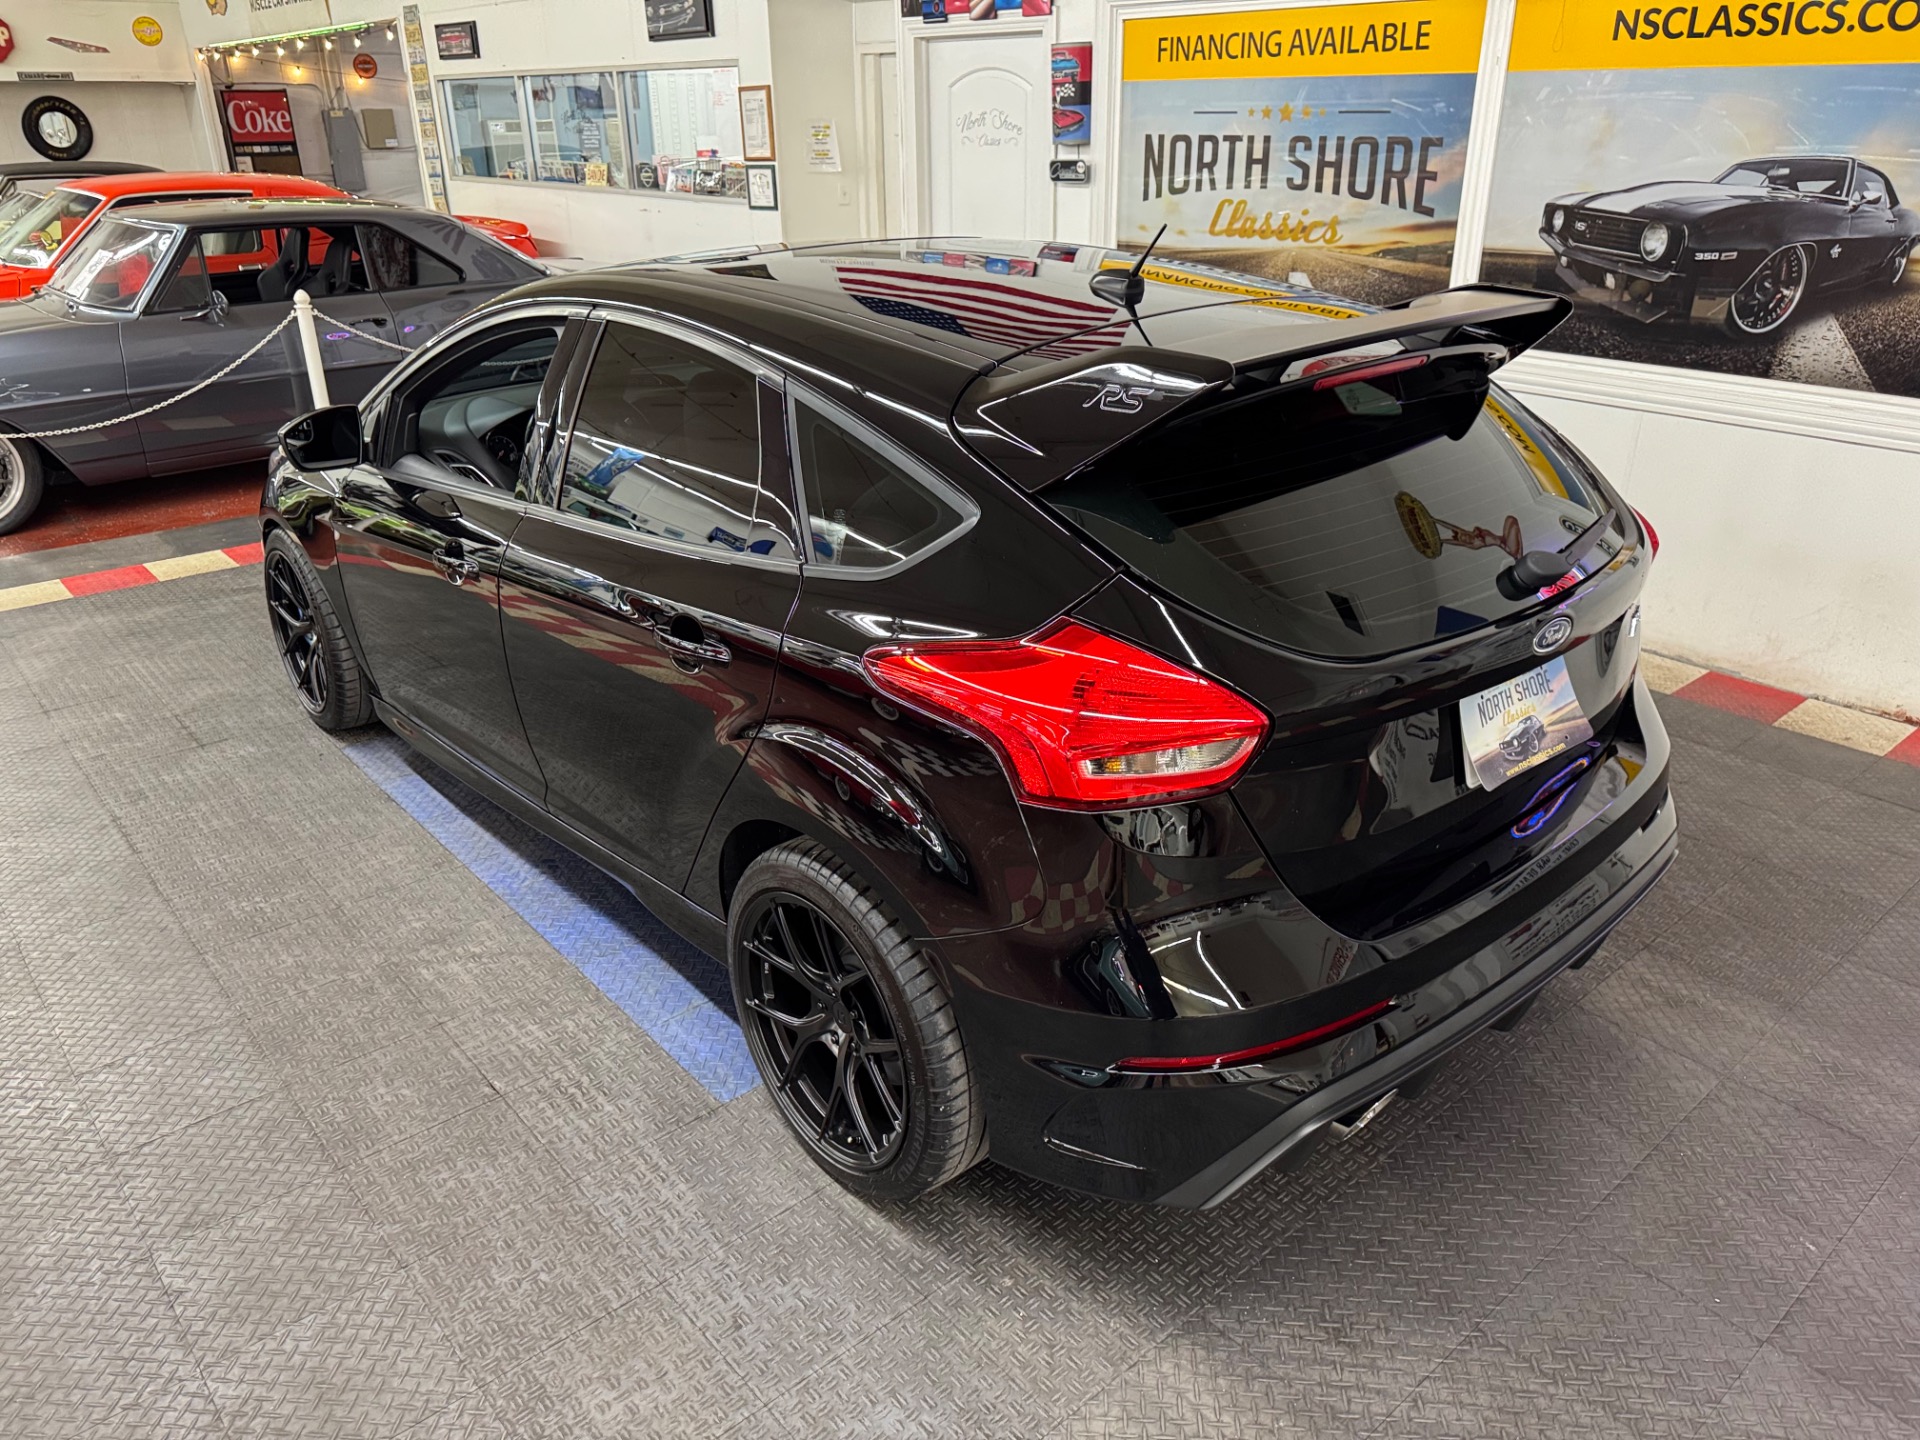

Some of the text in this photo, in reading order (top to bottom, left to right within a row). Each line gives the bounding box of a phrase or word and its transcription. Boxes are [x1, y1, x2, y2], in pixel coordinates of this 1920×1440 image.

[1157, 20, 1432, 62] FINANCING AVAILABLE
[227, 100, 293, 134] Coke
[956, 108, 1023, 136] North Shore
[1142, 134, 1444, 218] NORTH SHORE
[1208, 198, 1344, 245] Classics
[1694, 252, 1720, 261] 350
[1082, 383, 1155, 414] RS
[1542, 625, 1566, 646] Ford
[1477, 669, 1554, 728] NORTH SHORE
[1502, 702, 1538, 727] Classics
[1505, 742, 1567, 777] www.nsclassics.com
